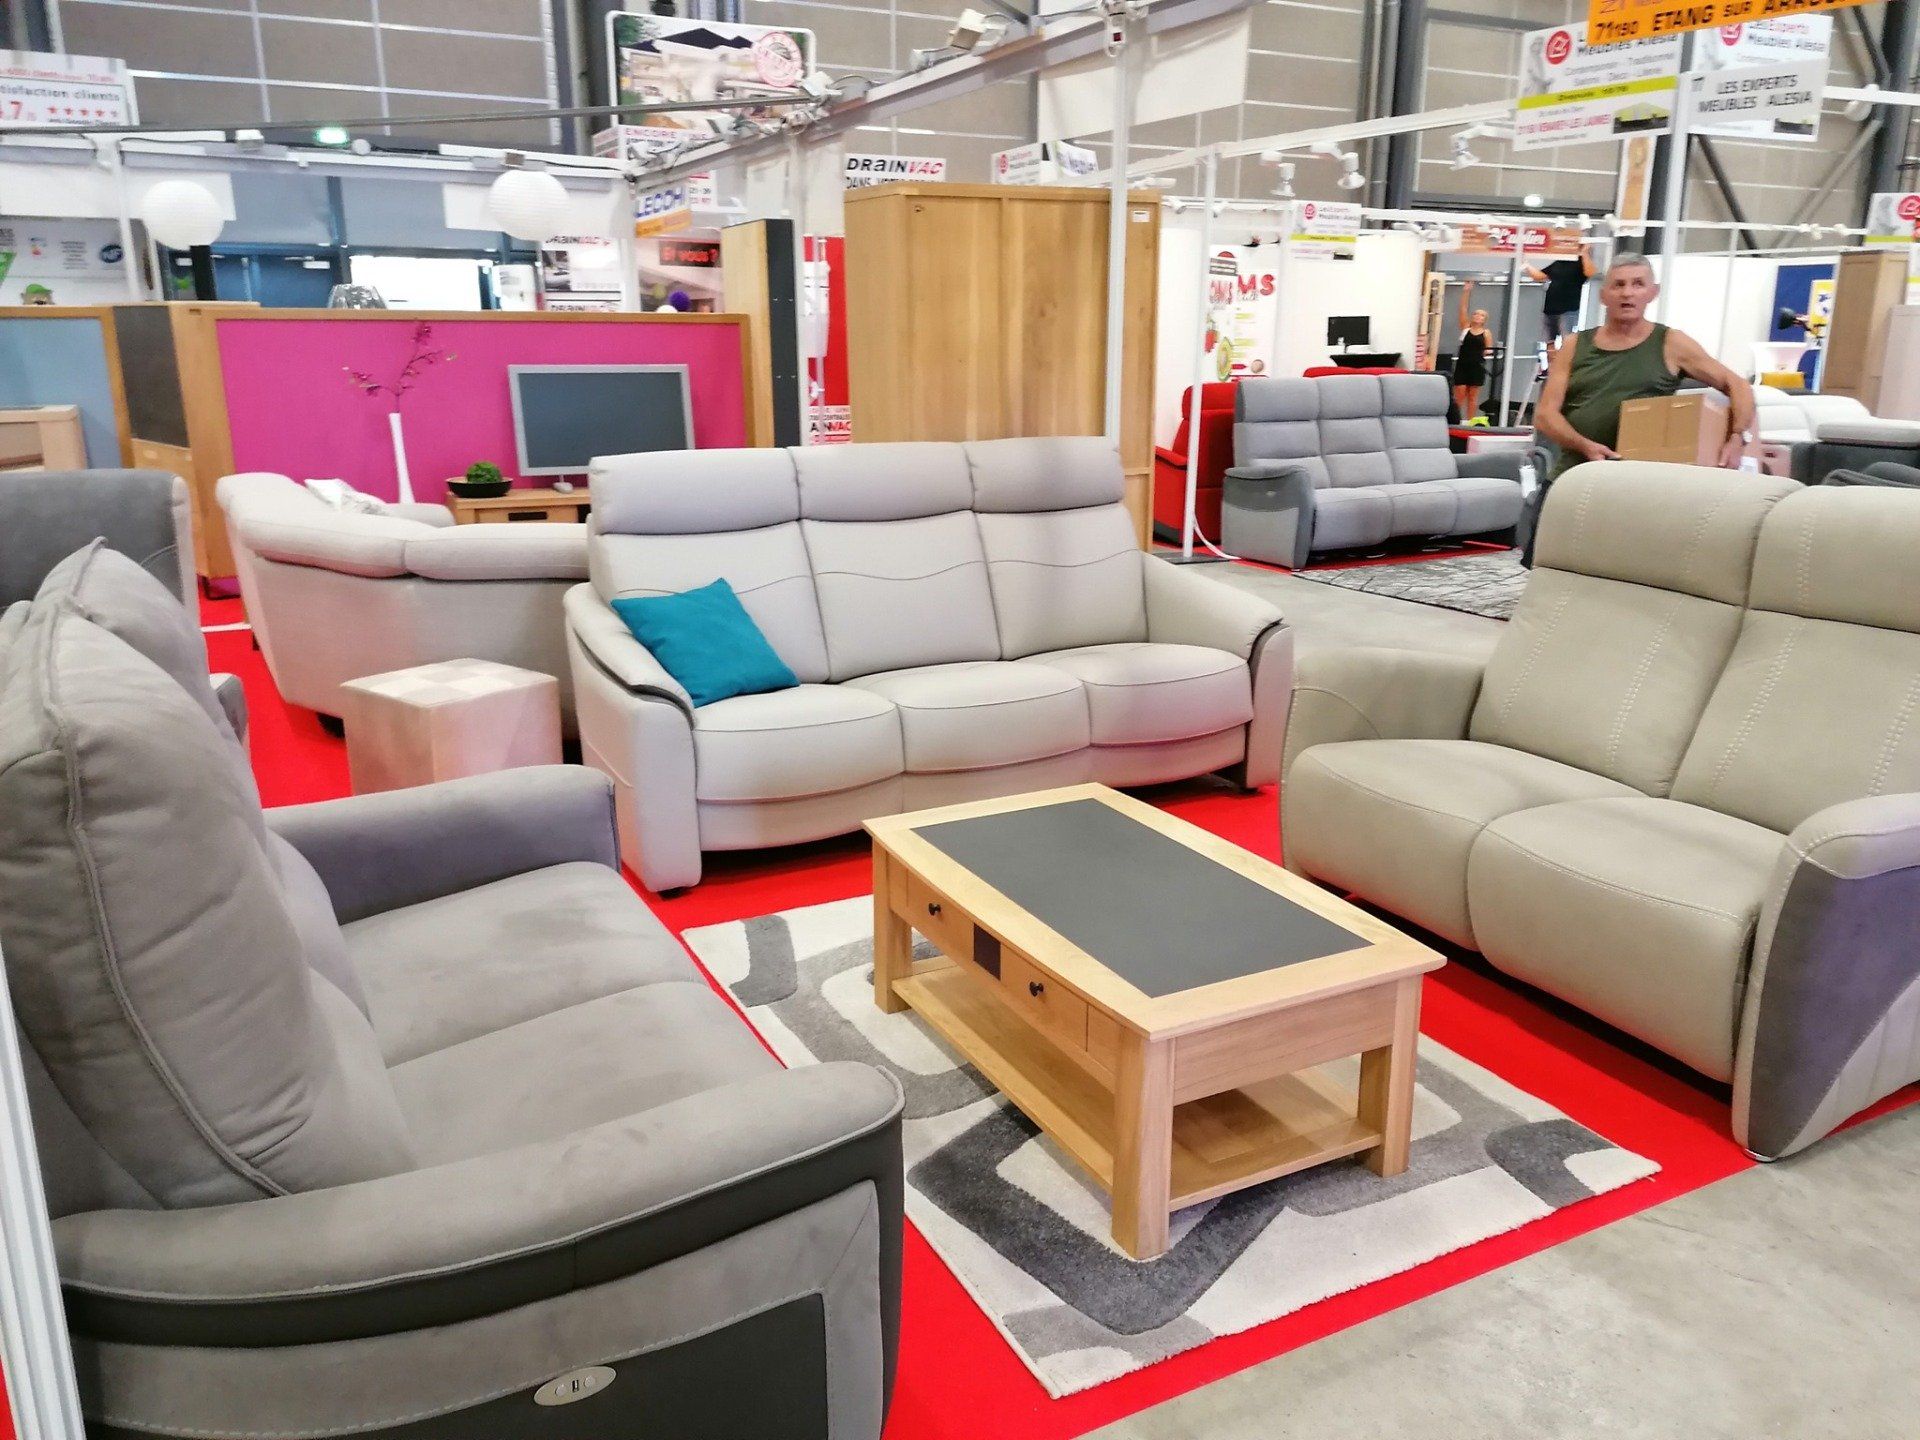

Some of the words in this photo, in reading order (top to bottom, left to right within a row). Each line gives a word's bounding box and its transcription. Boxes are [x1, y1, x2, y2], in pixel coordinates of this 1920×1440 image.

[1652, 5, 1713, 31] ETANG
[1715, 80, 1738, 95] LES
[1740, 74, 1798, 93] EXPERTS
[74, 89, 120, 102] clients
[1698, 96, 1758, 113] MEUBLES
[1765, 91, 1813, 107] ALESIA
